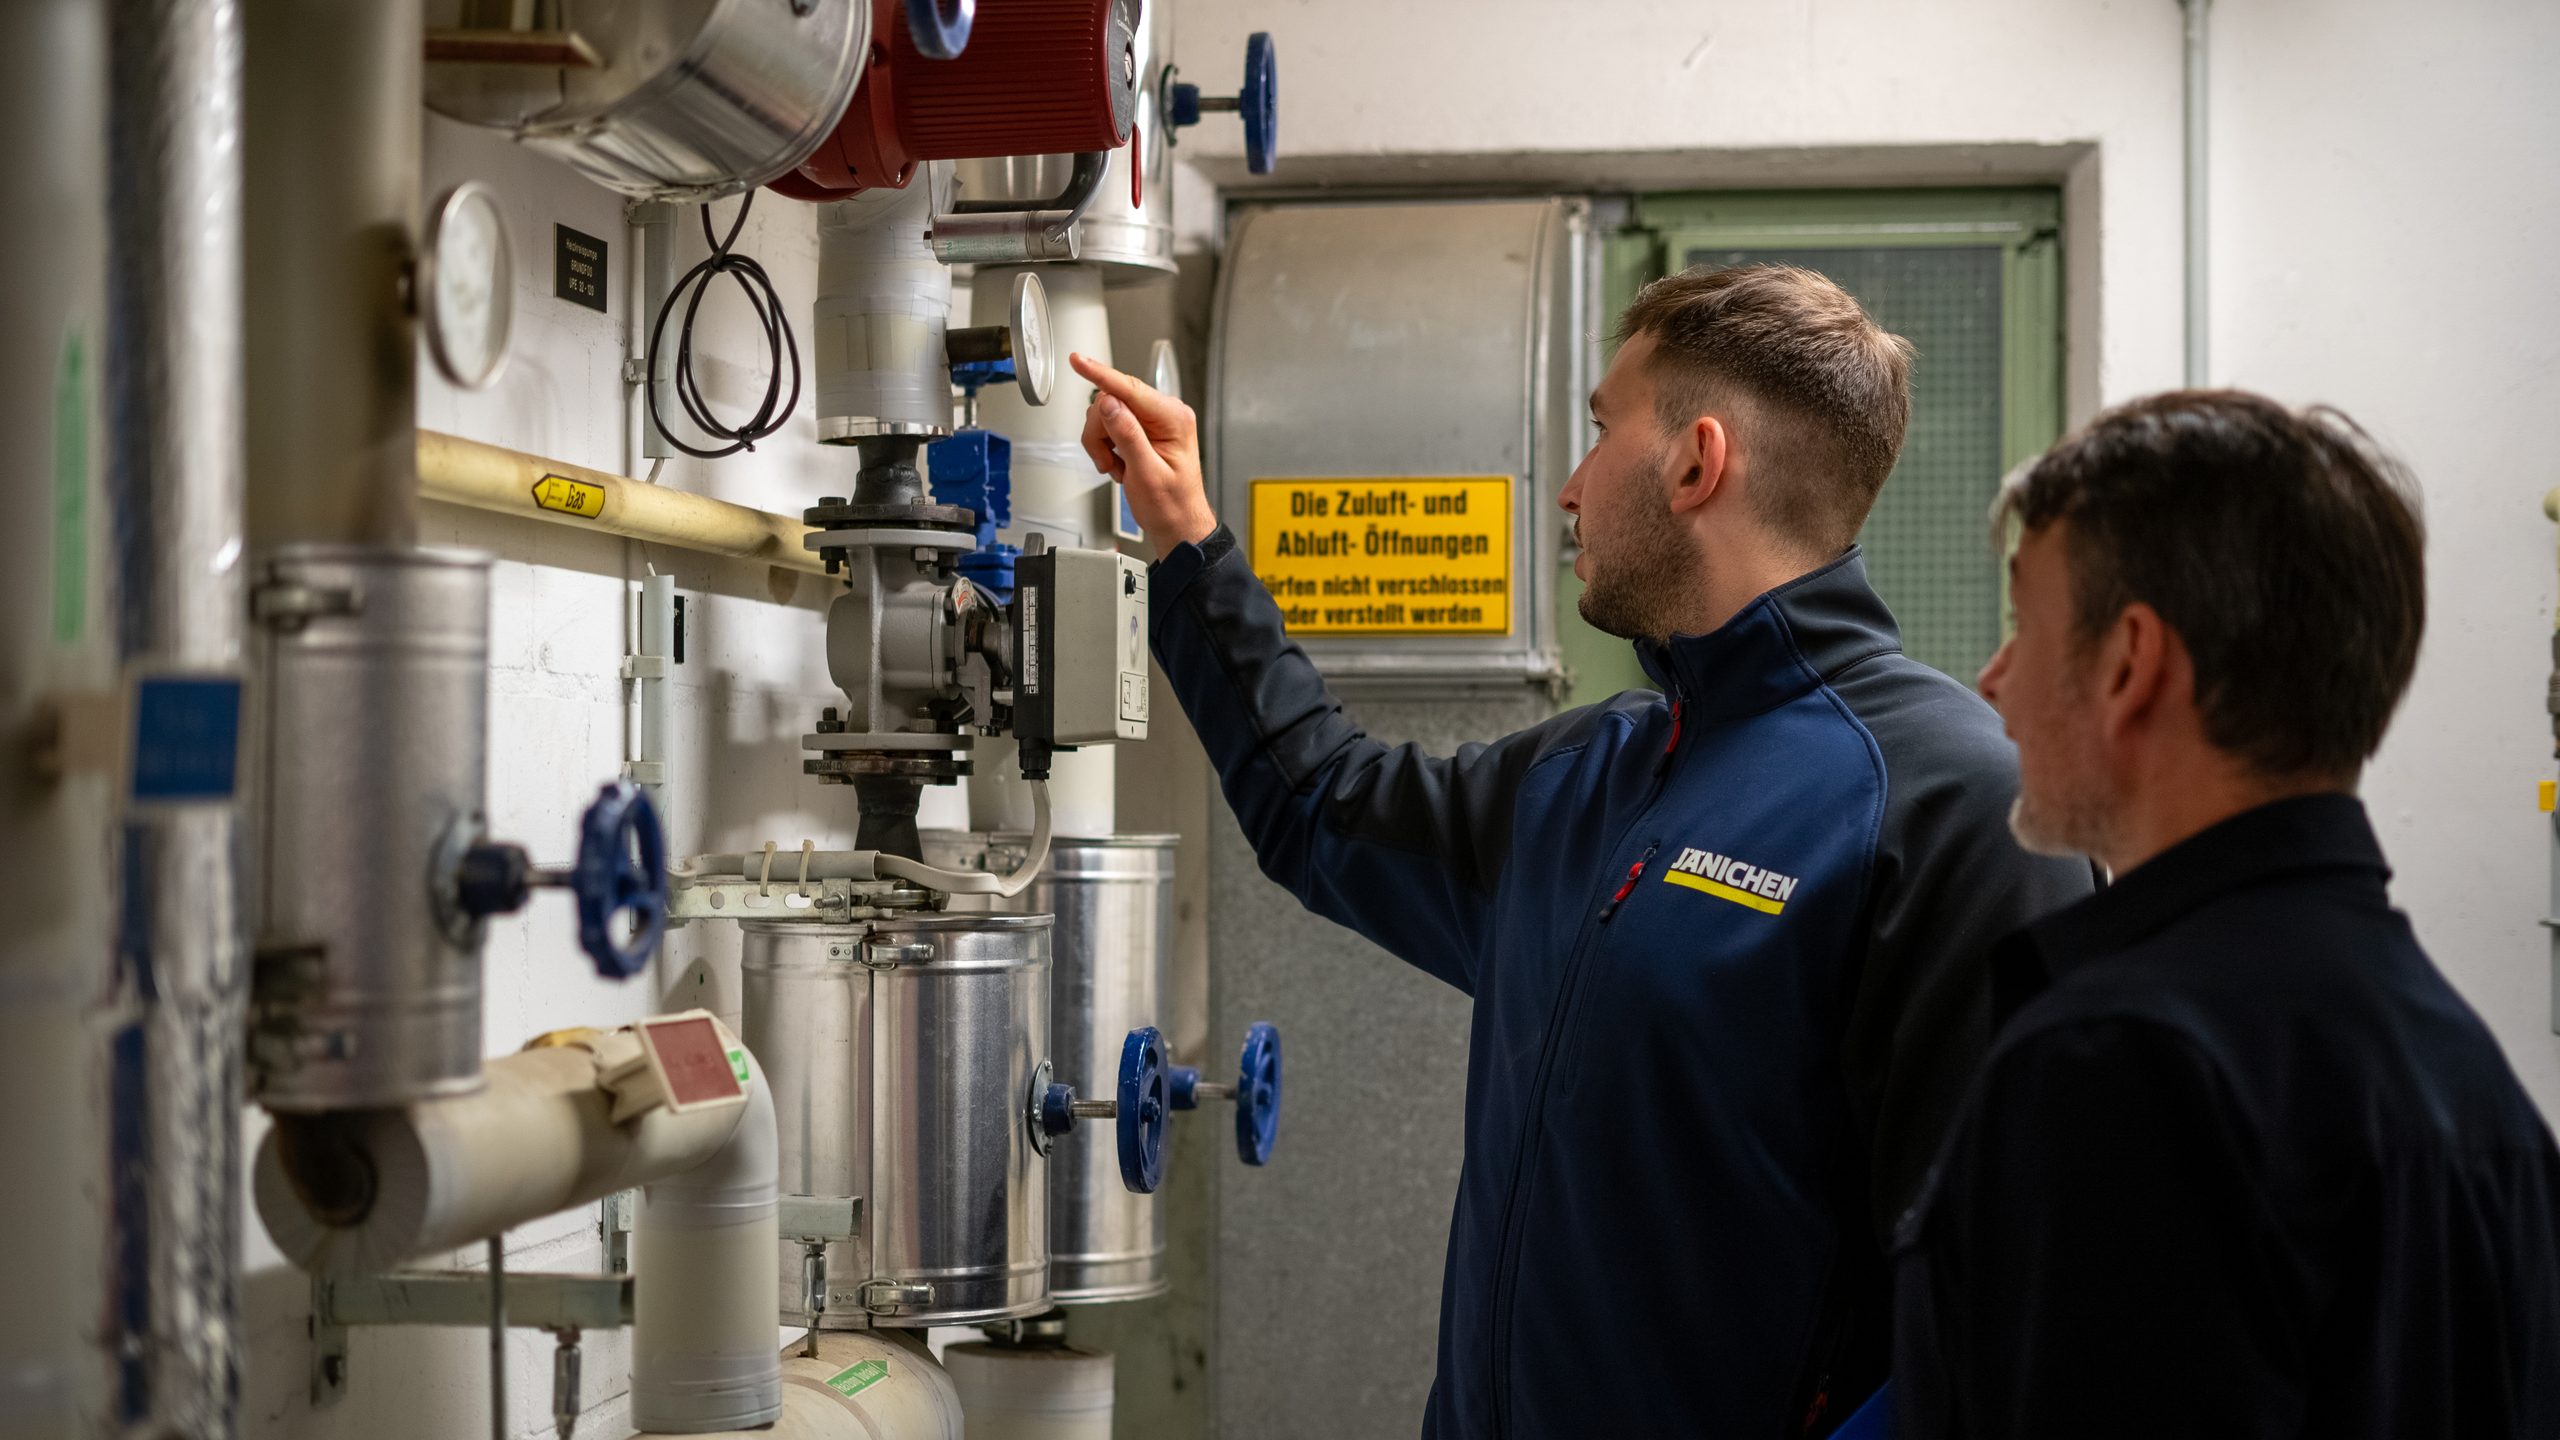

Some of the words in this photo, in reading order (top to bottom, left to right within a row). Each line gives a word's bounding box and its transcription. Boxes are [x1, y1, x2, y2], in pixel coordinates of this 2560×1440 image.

[565, 483, 586, 510] Gas
[1291, 490, 1328, 517] Die
[1336, 490, 1416, 516] Zuluft-
[1423, 489, 1467, 515] und
[1276, 530, 1357, 557] Abluft-
[1364, 523, 1488, 559] Öffnungen
[1261, 575, 1317, 597] ürfen
[1323, 575, 1371, 596] nicht
[1376, 574, 1505, 595] verschlossen
[1324, 604, 1404, 624] verstellt
[1410, 603, 1482, 623] werden
[1670, 847, 1799, 901] JÄNICHEN
